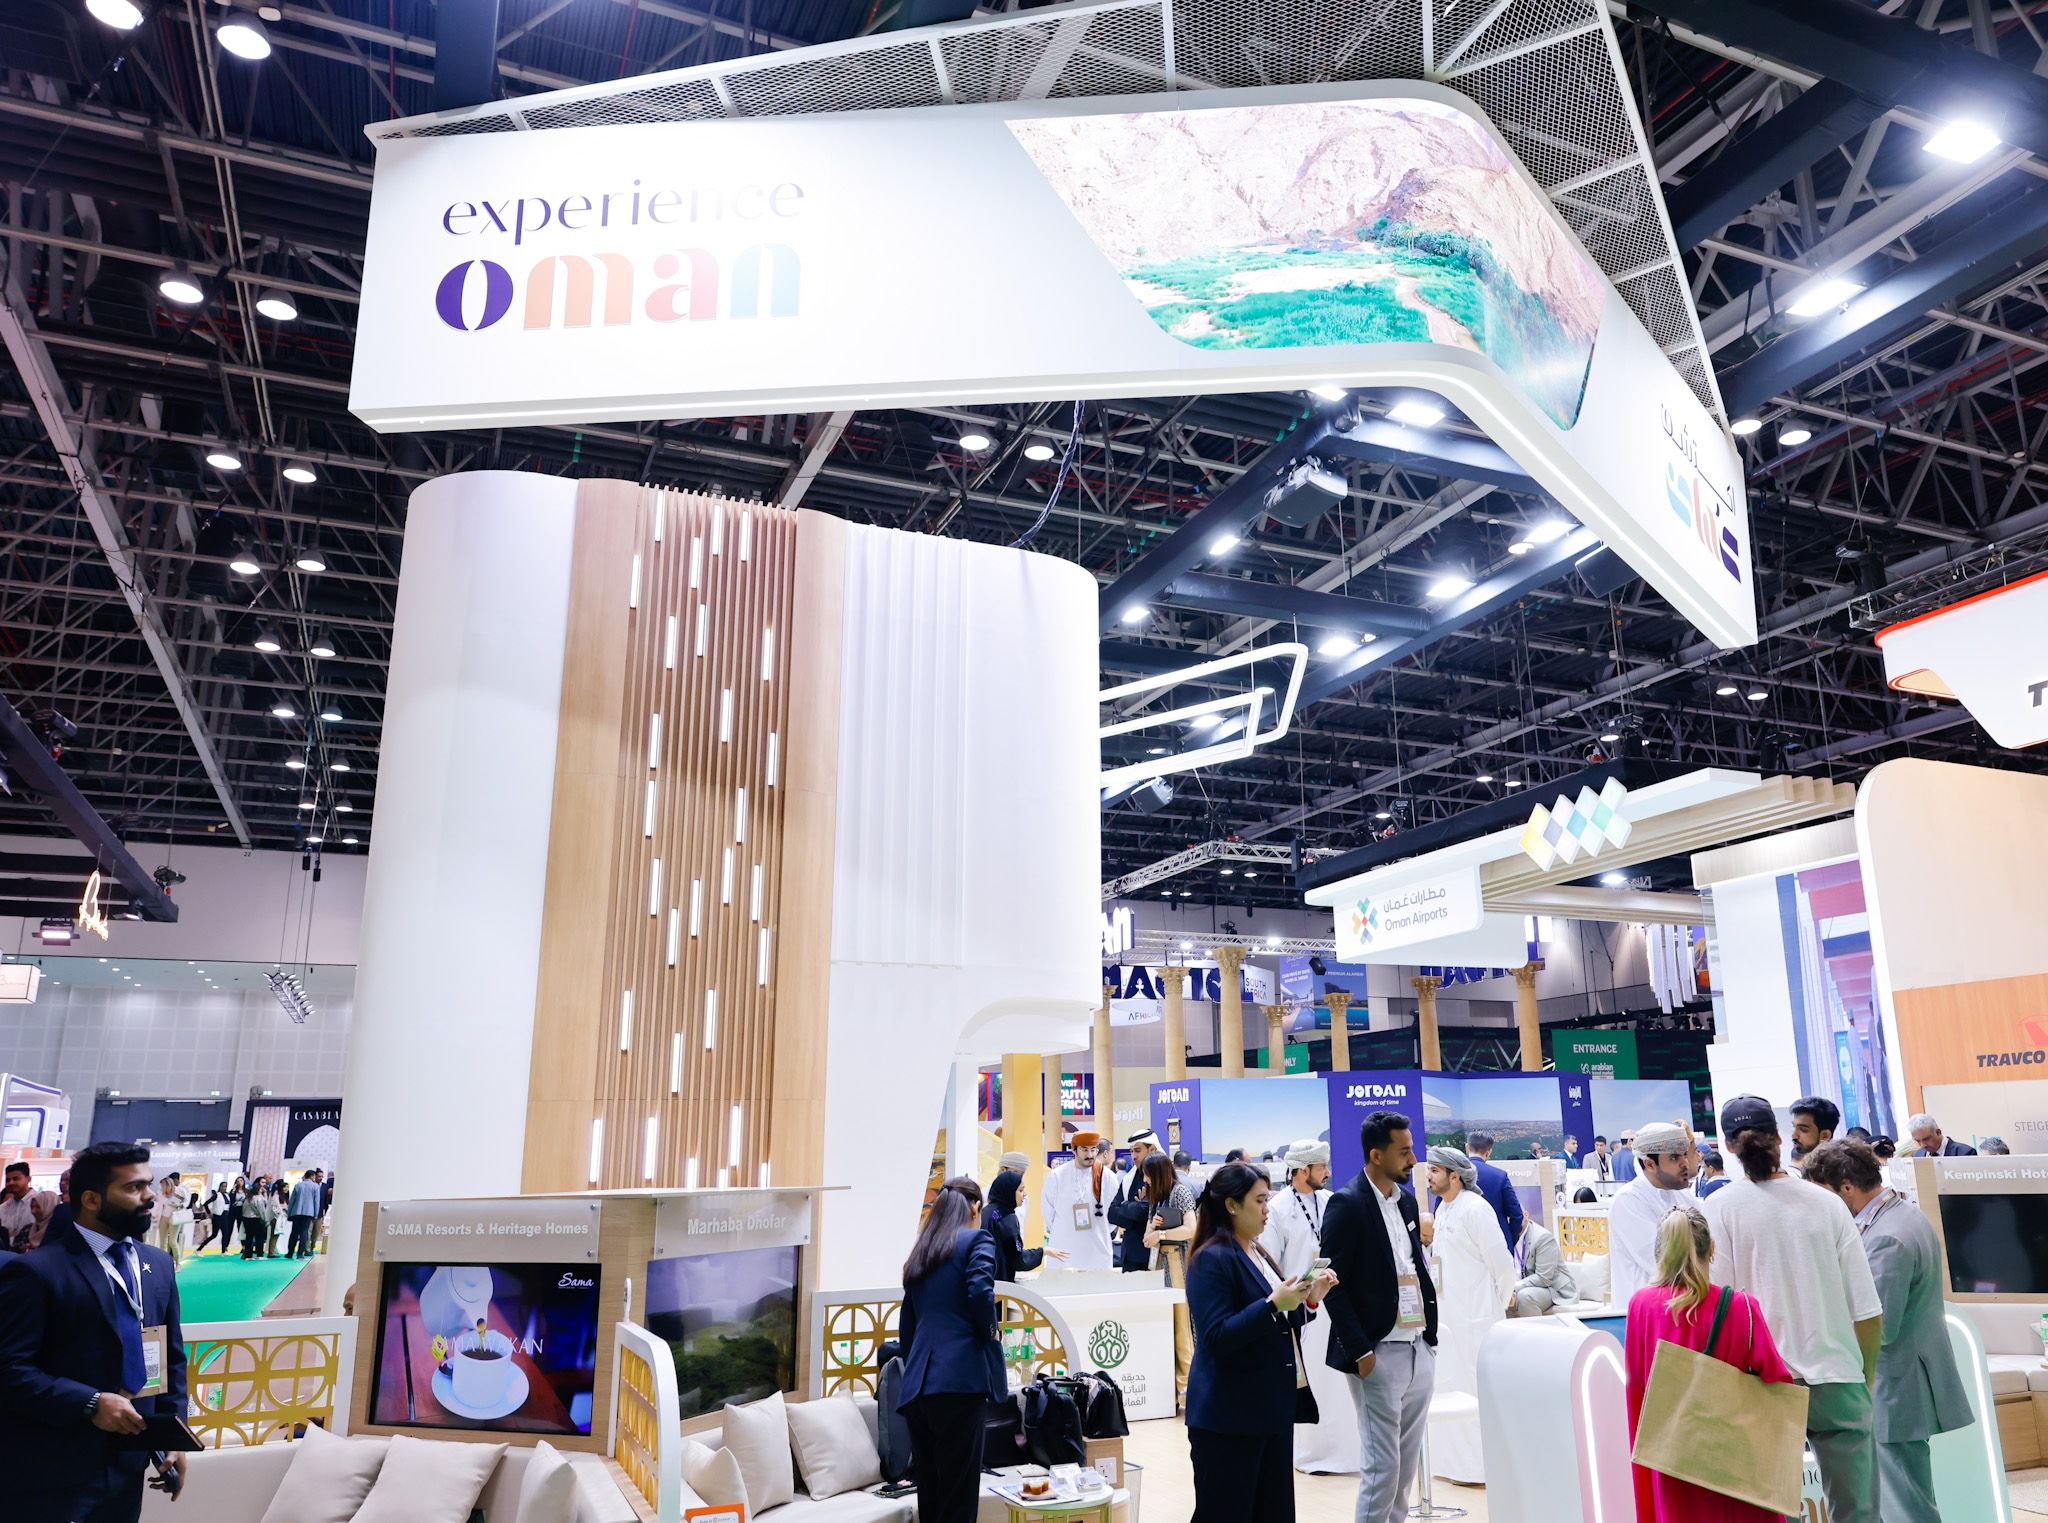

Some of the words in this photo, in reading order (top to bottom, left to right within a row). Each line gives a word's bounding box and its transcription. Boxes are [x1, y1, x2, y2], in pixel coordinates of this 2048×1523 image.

[442, 178, 805, 246] experience
[435, 242, 802, 332] oman
[1385, 917, 1411, 931] Oman
[1412, 907, 1448, 925] Airports
[1573, 1044, 1618, 1053] ENTRANCE
[1976, 1050, 2046, 1067] TRAVCO
[1591, 1063, 1614, 1071] arabian
[1944, 1169, 2017, 1181] Kempinski
[387, 1223, 422, 1236] SAMA
[426, 1223, 472, 1235] Resorts
[476, 1223, 485, 1234] &
[489, 1222, 542, 1238] Heritage
[545, 1222, 589, 1234] Homes
[687, 1216, 743, 1235] Marhaba
[747, 1214, 786, 1230] Dhofar
[558, 1272, 594, 1287] Sama
[1121, 1373, 1146, 1383] حديقة
